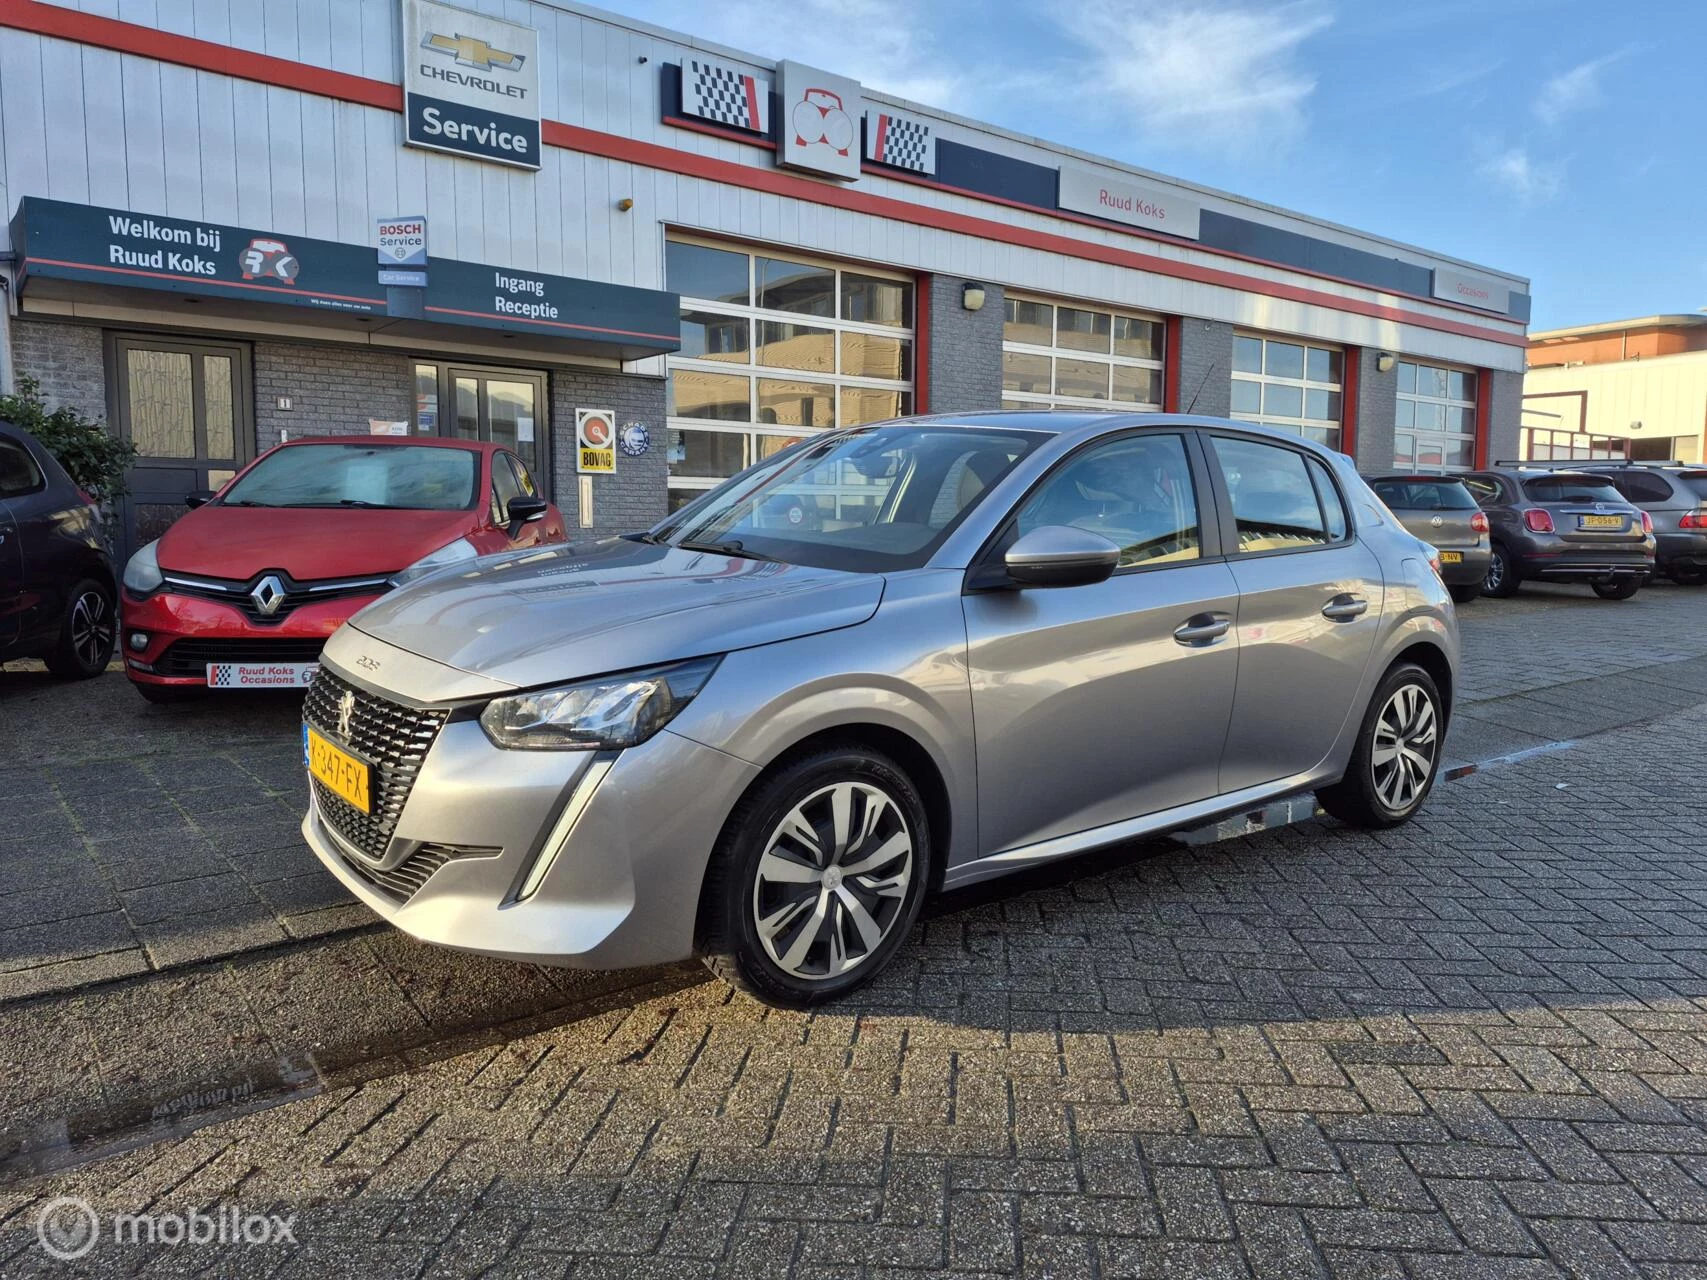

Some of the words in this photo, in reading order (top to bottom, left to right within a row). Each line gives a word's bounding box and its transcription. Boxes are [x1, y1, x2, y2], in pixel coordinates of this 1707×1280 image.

[420, 64, 528, 99] CHEVROLET
[422, 107, 528, 153] Service
[1100, 188, 1132, 211] Ruud
[1136, 199, 1166, 219] Koks
[109, 215, 191, 245] Welkom
[196, 227, 221, 252] bij
[380, 224, 422, 236] BOSCH
[380, 237, 422, 246] Service
[109, 244, 163, 269] Ruud
[168, 252, 216, 276] Koks
[495, 272, 545, 297] Ingang
[495, 296, 559, 319] Receptie
[583, 451, 611, 467] BOVAG
[238, 666, 266, 675] Ruud
[268, 666, 295, 675] Koks
[240, 675, 295, 684] Occasions
